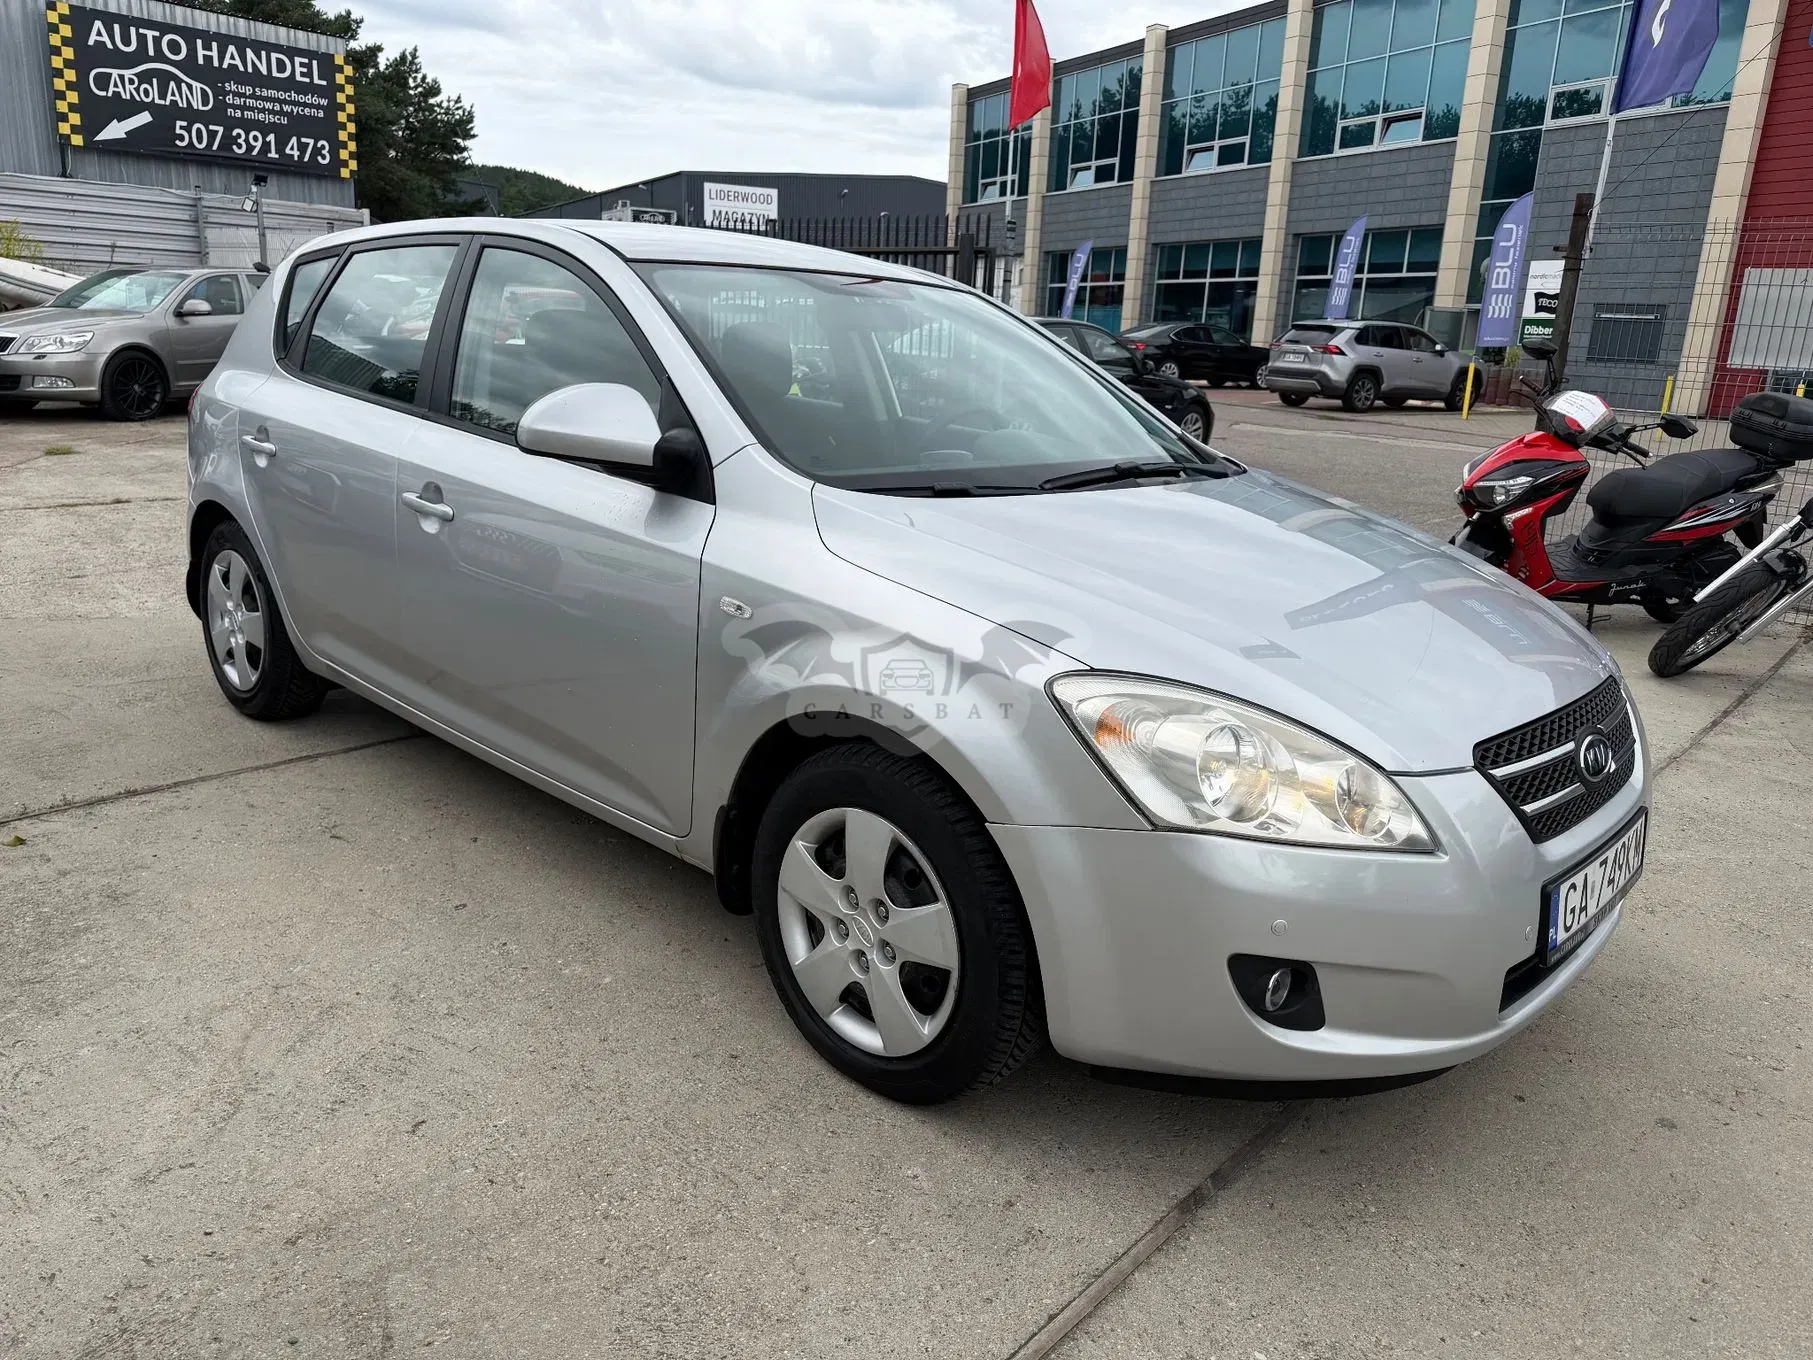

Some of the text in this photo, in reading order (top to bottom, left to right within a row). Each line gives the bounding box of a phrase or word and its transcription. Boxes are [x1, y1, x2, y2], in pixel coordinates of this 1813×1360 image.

[87, 19, 328, 86] AUTO HANDEL
[224, 80, 254, 95] skup
[255, 86, 329, 107] samochodów
[225, 93, 281, 111] darmowa
[281, 104, 325, 118] wycena
[227, 107, 288, 125] na miejscu
[174, 120, 331, 165] 507 391 473
[708, 188, 774, 205] LIDERWOOD
[1335, 236, 1356, 284] BLU
[1491, 223, 1517, 289] BLU
[1537, 298, 1558, 308] TECO
[1524, 325, 1554, 335] Dibber
[1563, 822, 1643, 934] GA 749KM
[1549, 926, 1557, 943] PL
